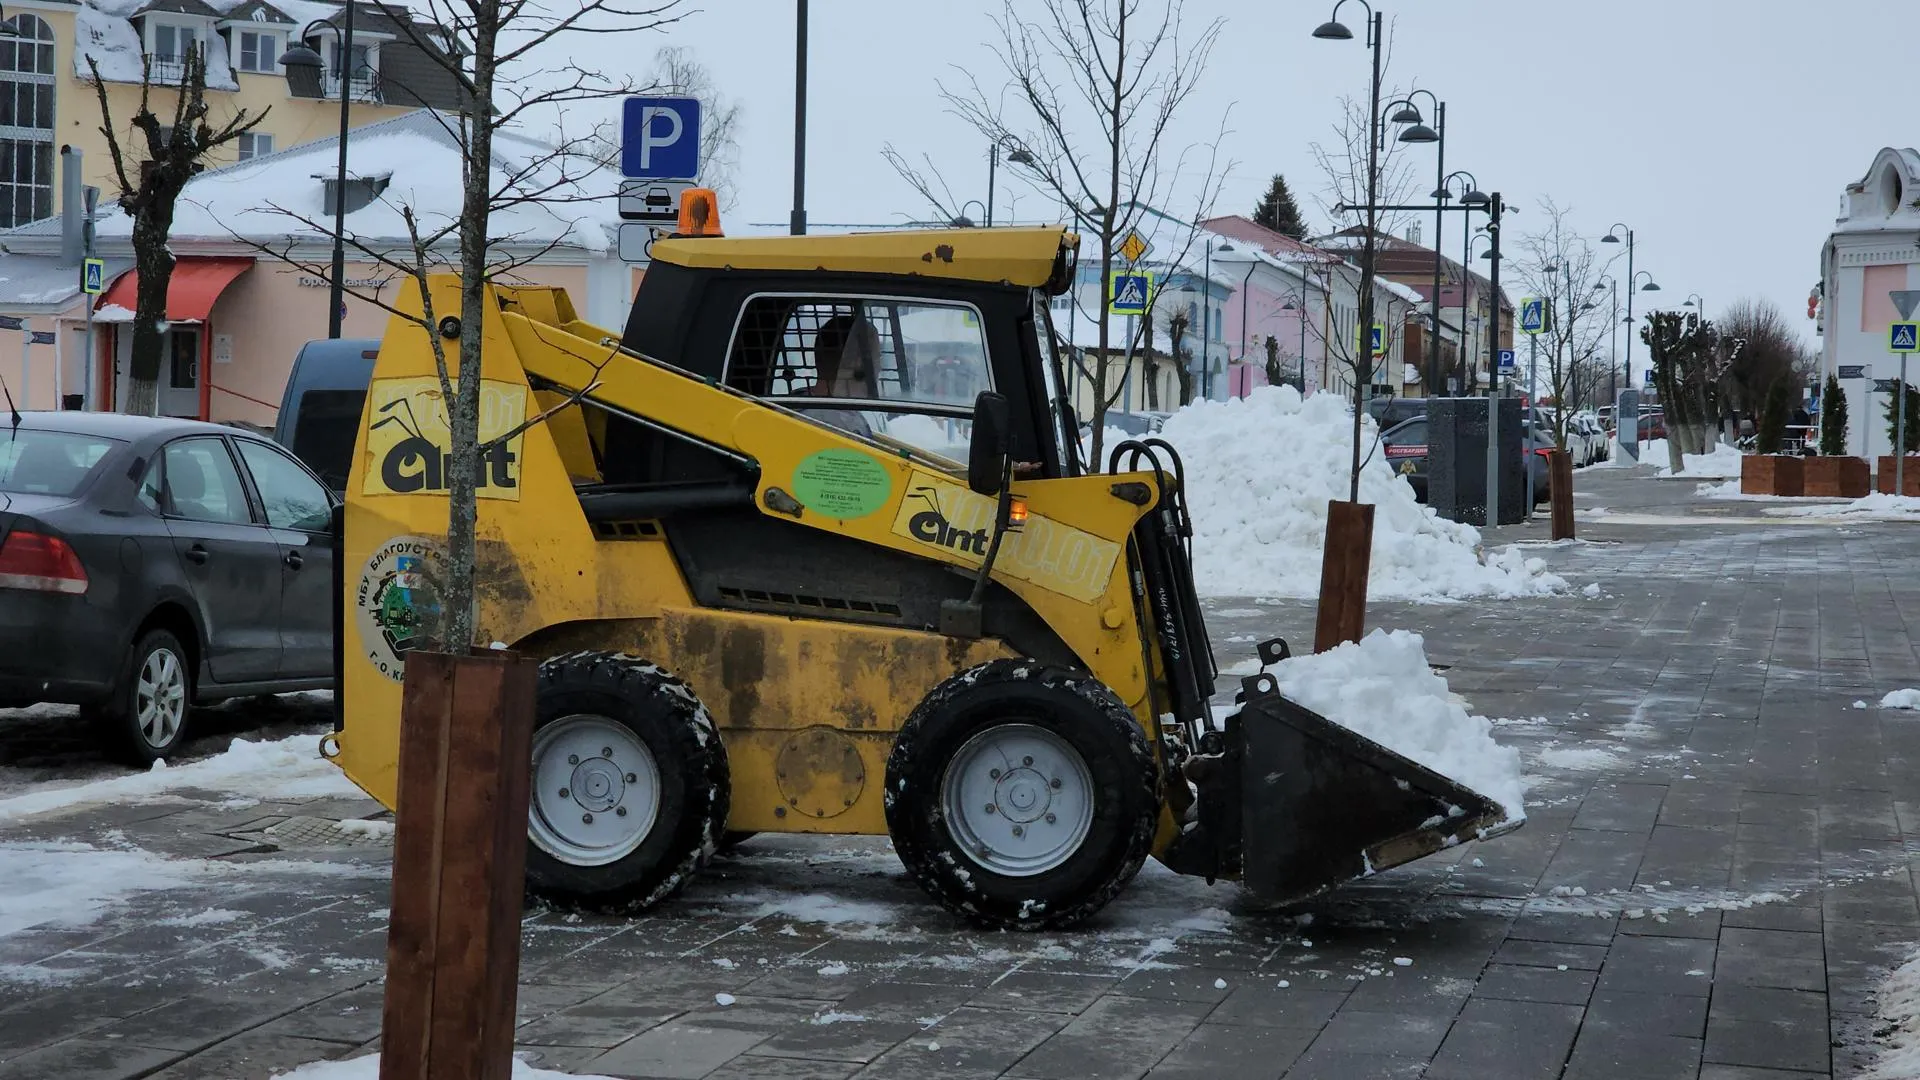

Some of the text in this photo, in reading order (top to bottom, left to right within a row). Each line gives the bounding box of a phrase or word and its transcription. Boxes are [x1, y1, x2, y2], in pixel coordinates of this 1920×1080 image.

[640, 106, 683, 169] P
[297, 276, 361, 288] Горокая
[1501, 352, 1512, 366] P
[909, 512, 989, 555] ant
[358, 542, 450, 607] МБУ БЛАГОУСТРО
[392, 669, 405, 682] КА
